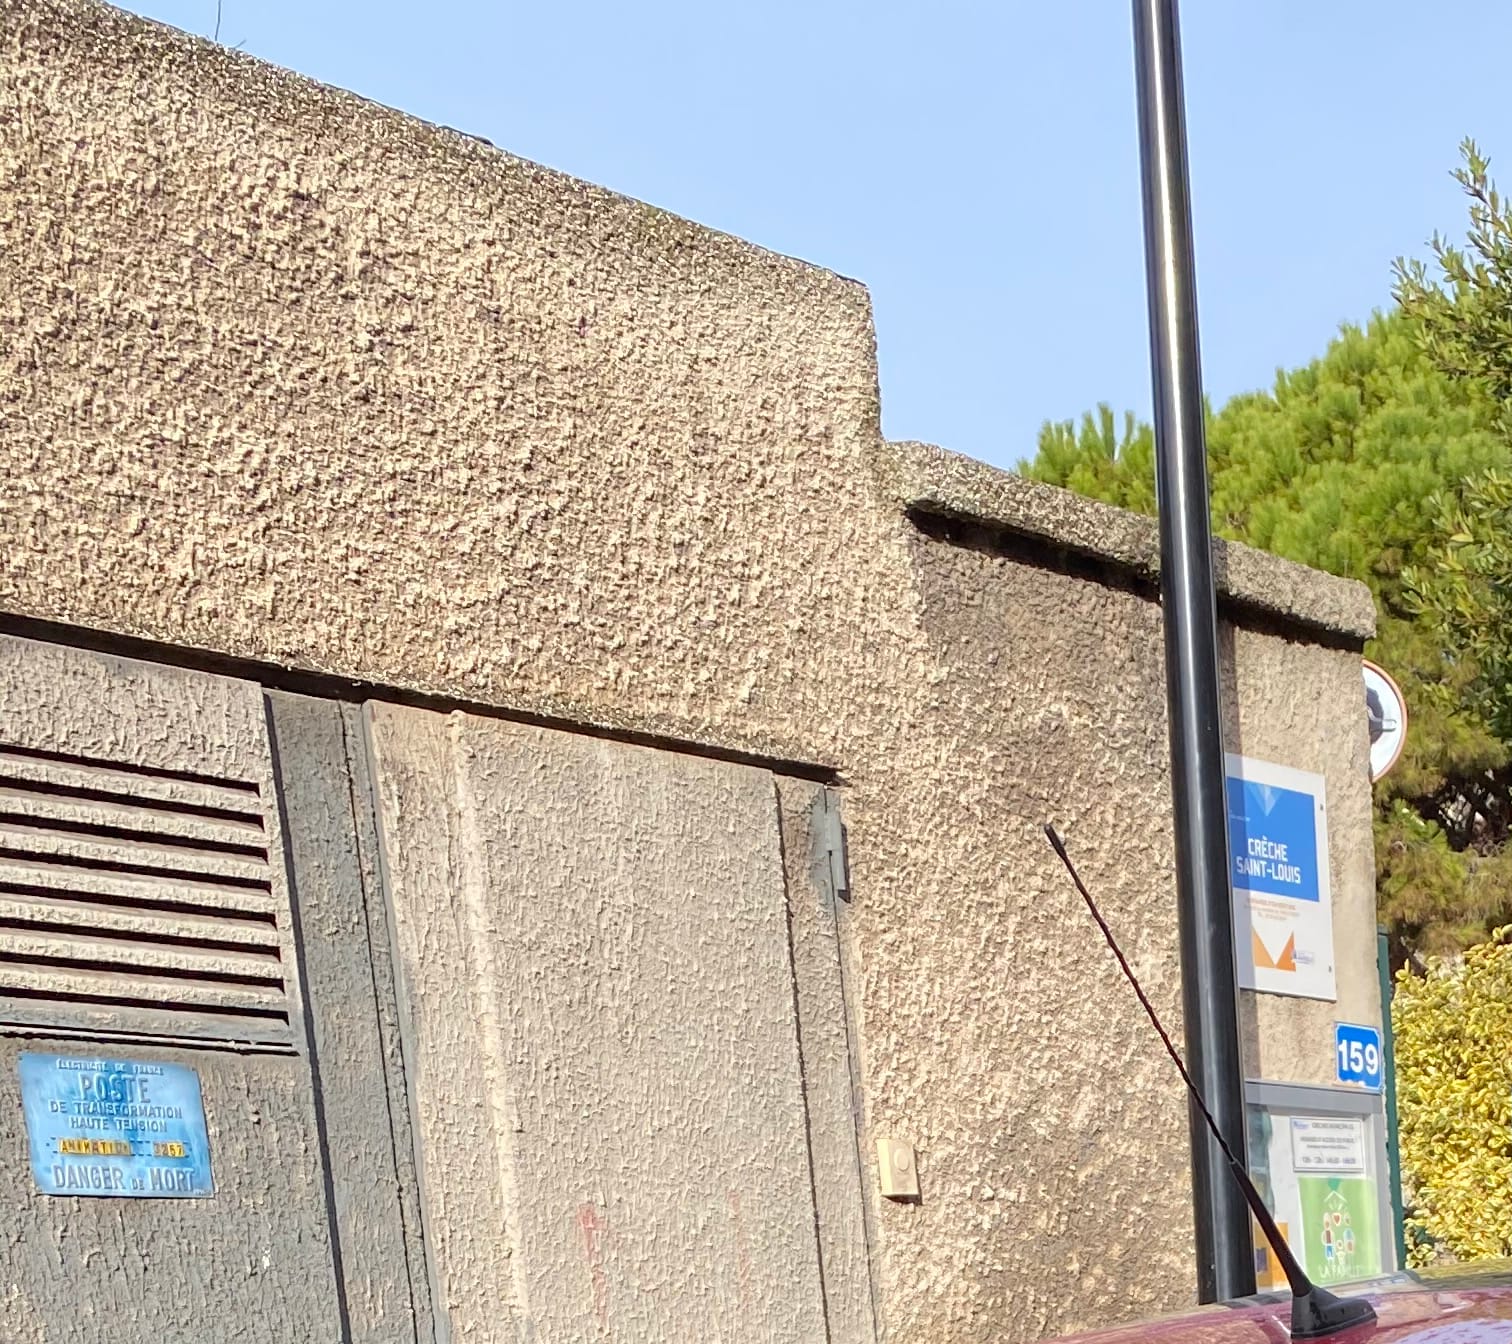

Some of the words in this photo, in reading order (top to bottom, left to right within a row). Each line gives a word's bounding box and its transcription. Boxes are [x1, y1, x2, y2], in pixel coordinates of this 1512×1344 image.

[1247, 835, 1288, 863] CRÈCHE
[1236, 856, 1301, 884] SAINT-LOUIS
[1338, 1039, 1379, 1075] 159
[78, 1071, 151, 1104] POSTE
[49, 1100, 68, 1114] DE
[72, 1101, 183, 1119] TRANSFORMATION
[70, 1116, 110, 1131] HAUTE
[115, 1118, 168, 1133] TENSION
[53, 1164, 126, 1191] DANGER
[131, 1178, 145, 1191] DE
[150, 1167, 195, 1193] MORT
